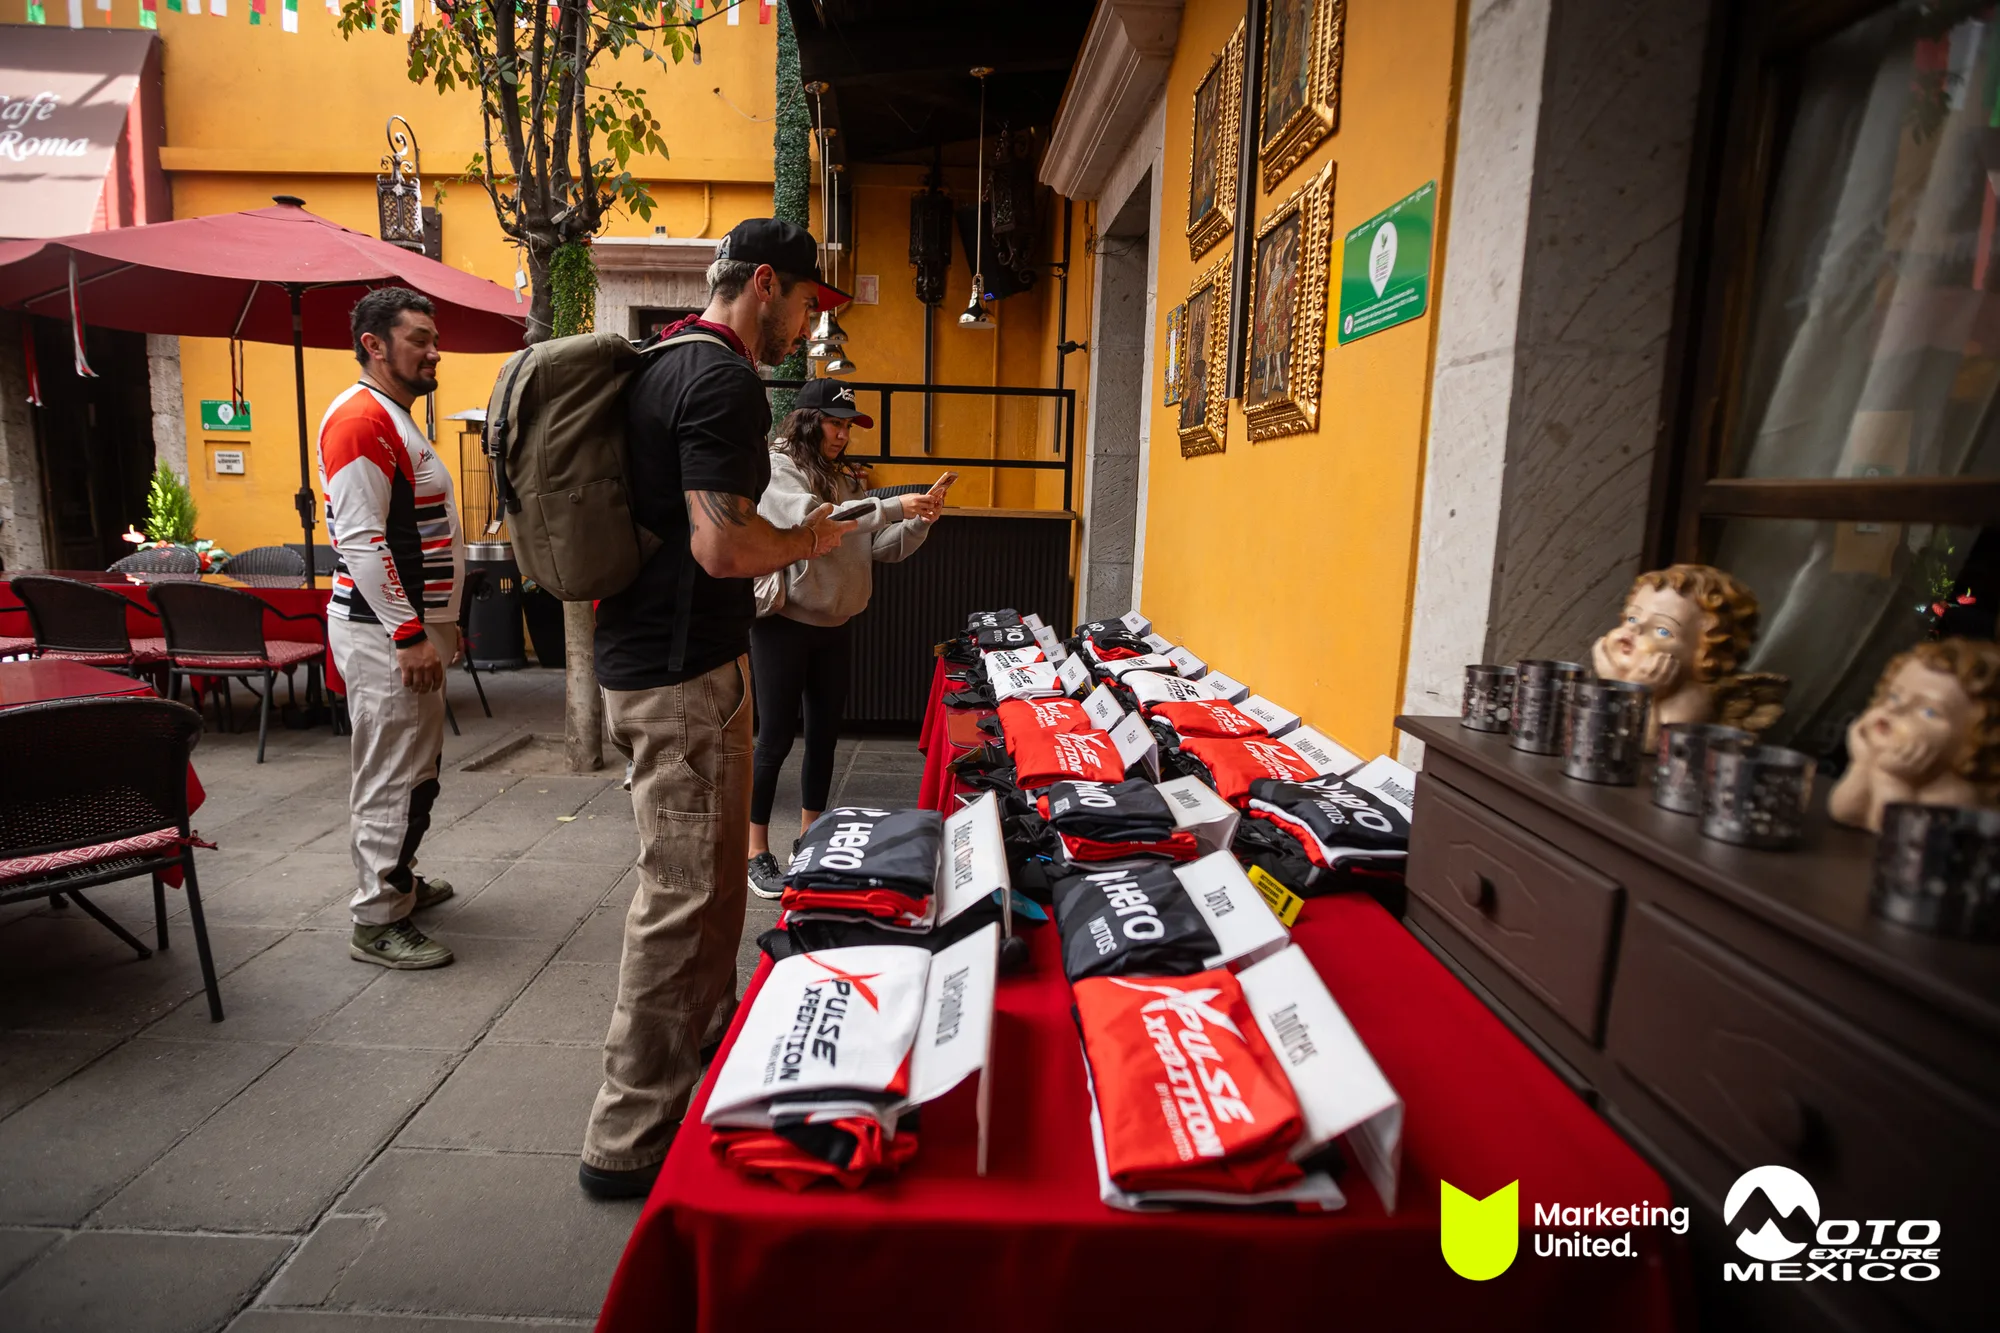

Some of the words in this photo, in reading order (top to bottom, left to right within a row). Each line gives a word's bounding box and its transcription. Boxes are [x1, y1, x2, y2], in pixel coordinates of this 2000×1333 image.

[1293, 738, 1316, 759] Edgar
[1309, 747, 1332, 765] Flores
[819, 821, 874, 870] Hero
[1088, 916, 1118, 956] MOTOS
[779, 986, 822, 1083] XPEDITION
